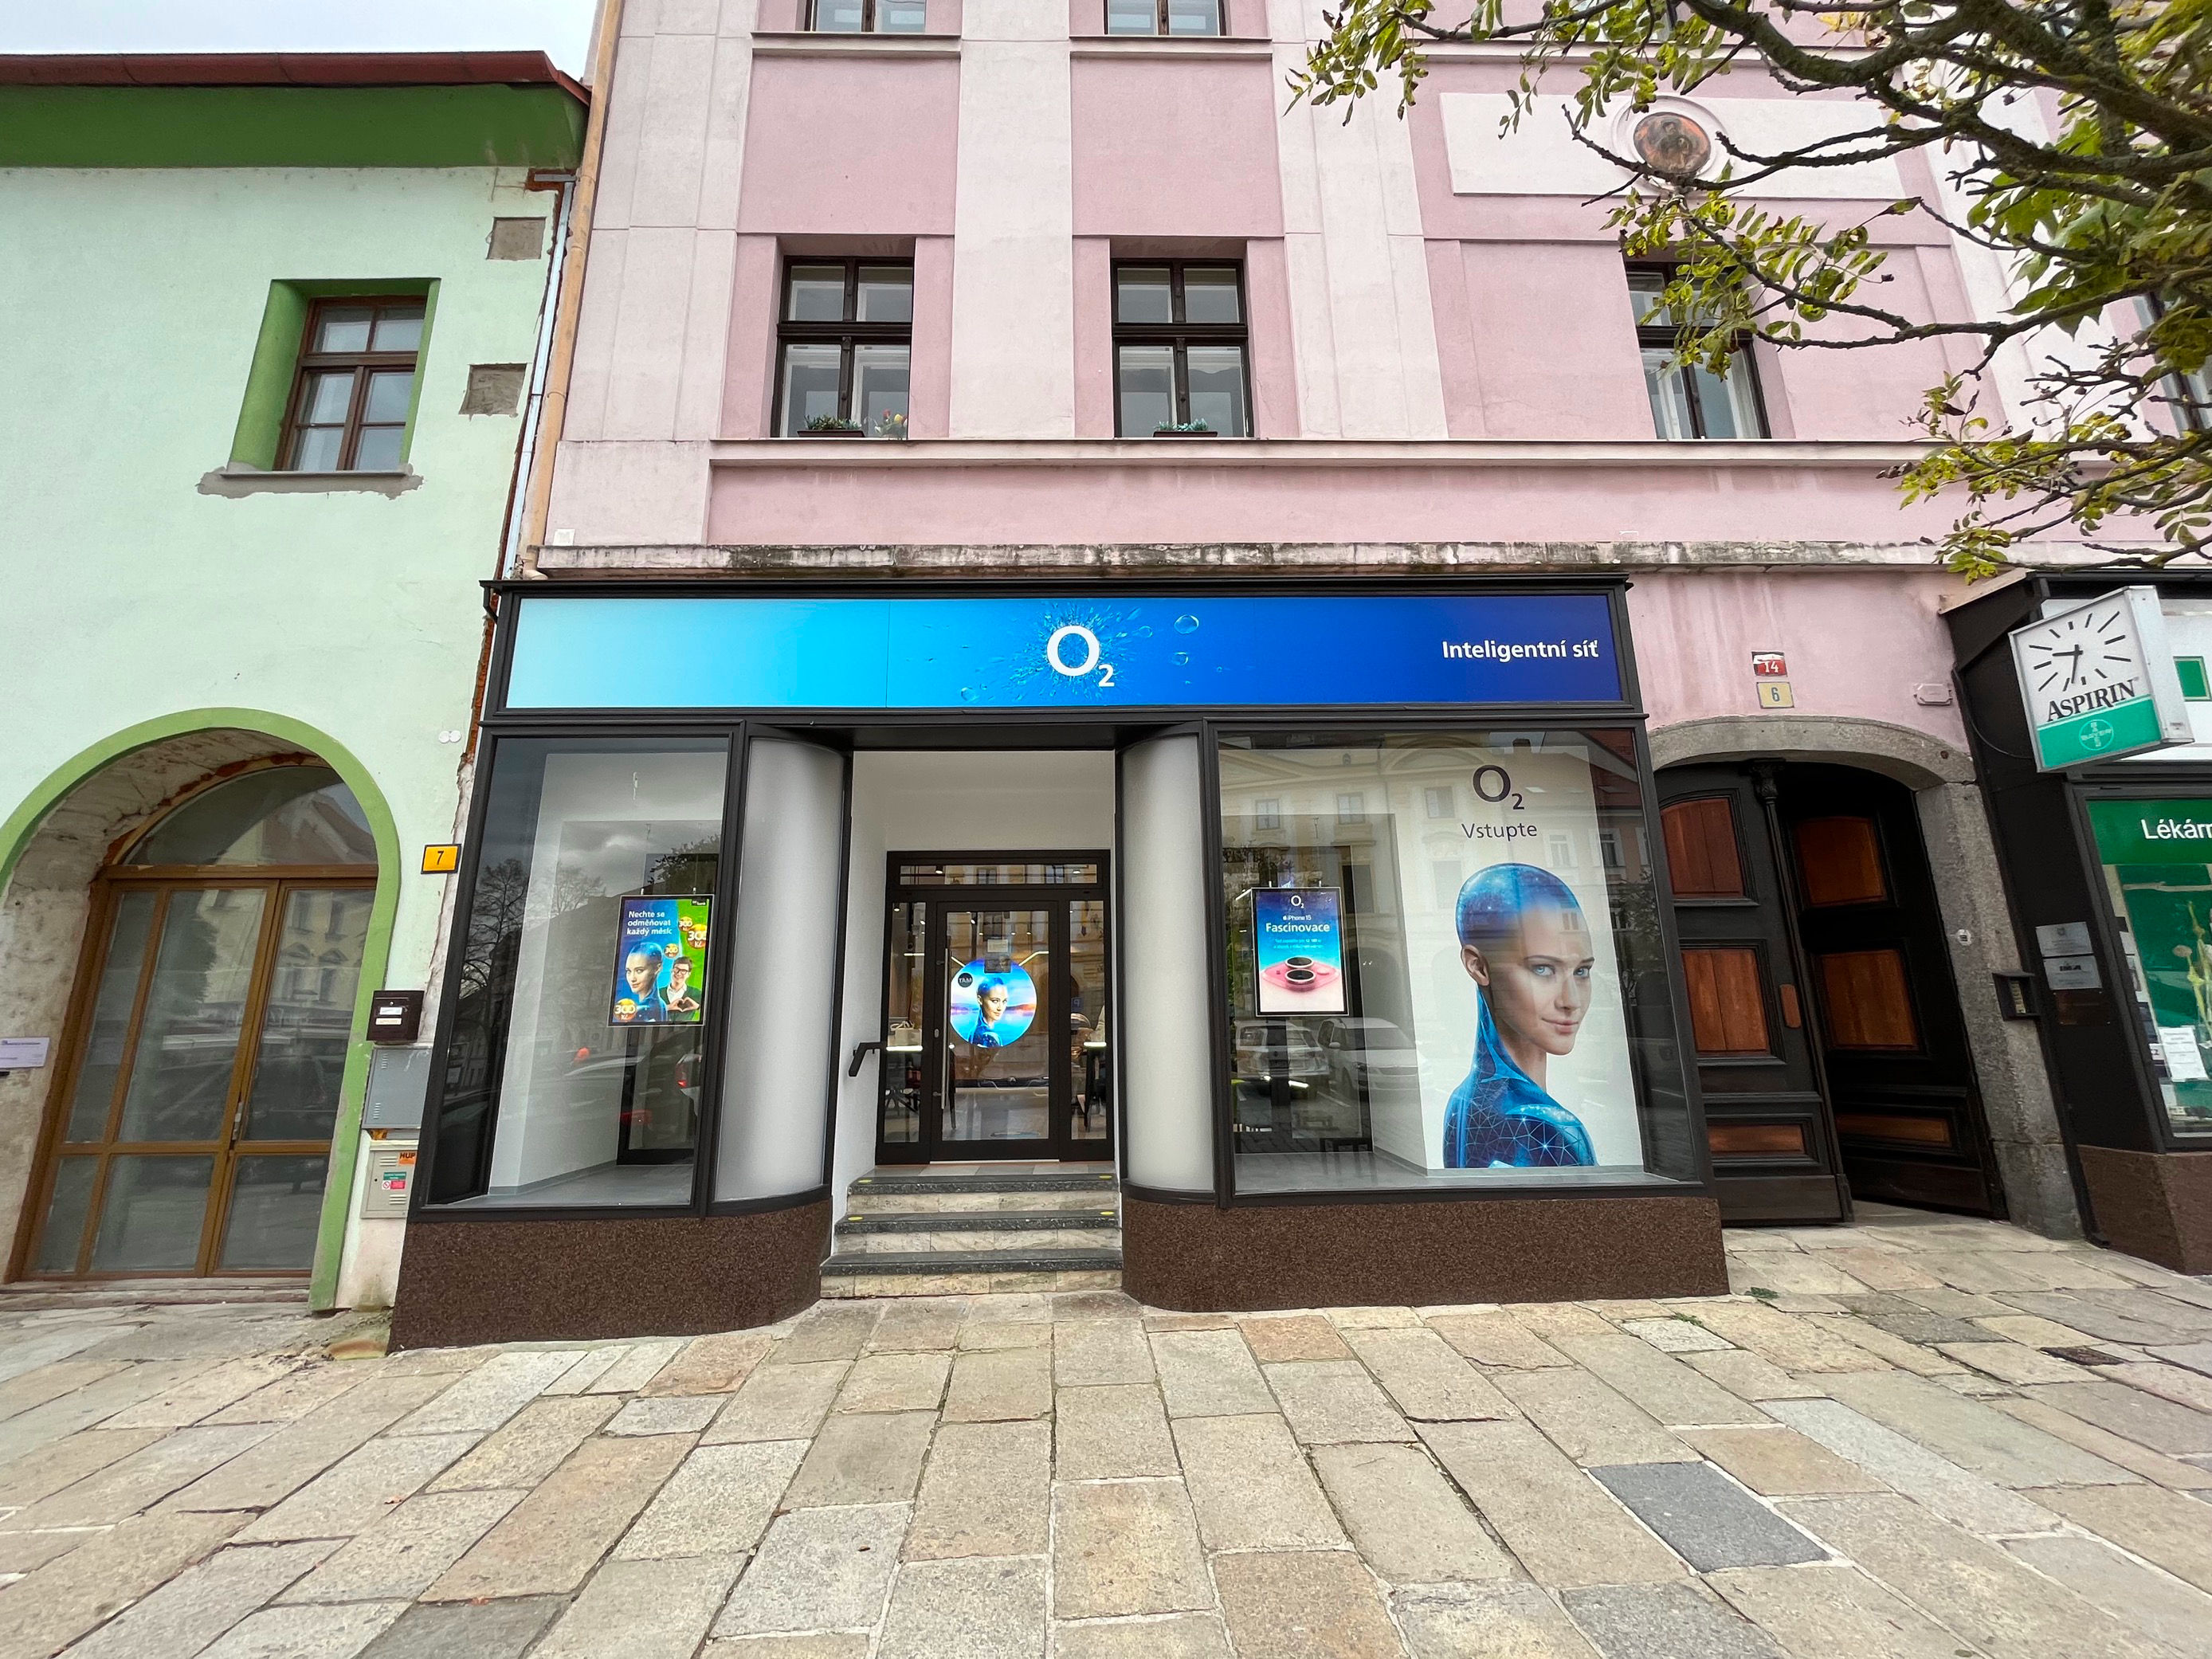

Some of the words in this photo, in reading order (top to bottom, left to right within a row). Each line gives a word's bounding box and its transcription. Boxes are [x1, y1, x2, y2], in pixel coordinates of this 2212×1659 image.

[1047, 625, 1115, 688] O2
[1442, 640, 1567, 662] Inteligentní
[1572, 640, 1599, 657] síť
[1764, 661, 1779, 673] 14
[1771, 687, 1780, 702] 6
[2047, 677, 2139, 722] ASPIRIN
[1473, 764, 1525, 810] O2
[1461, 822, 1538, 842] Vstupte
[437, 849, 445, 866] 7
[1290, 895, 1304, 909] O2
[628, 910, 655, 919] Nechte
[626, 928, 650, 937] každý
[614, 1005, 636, 1014] 300
